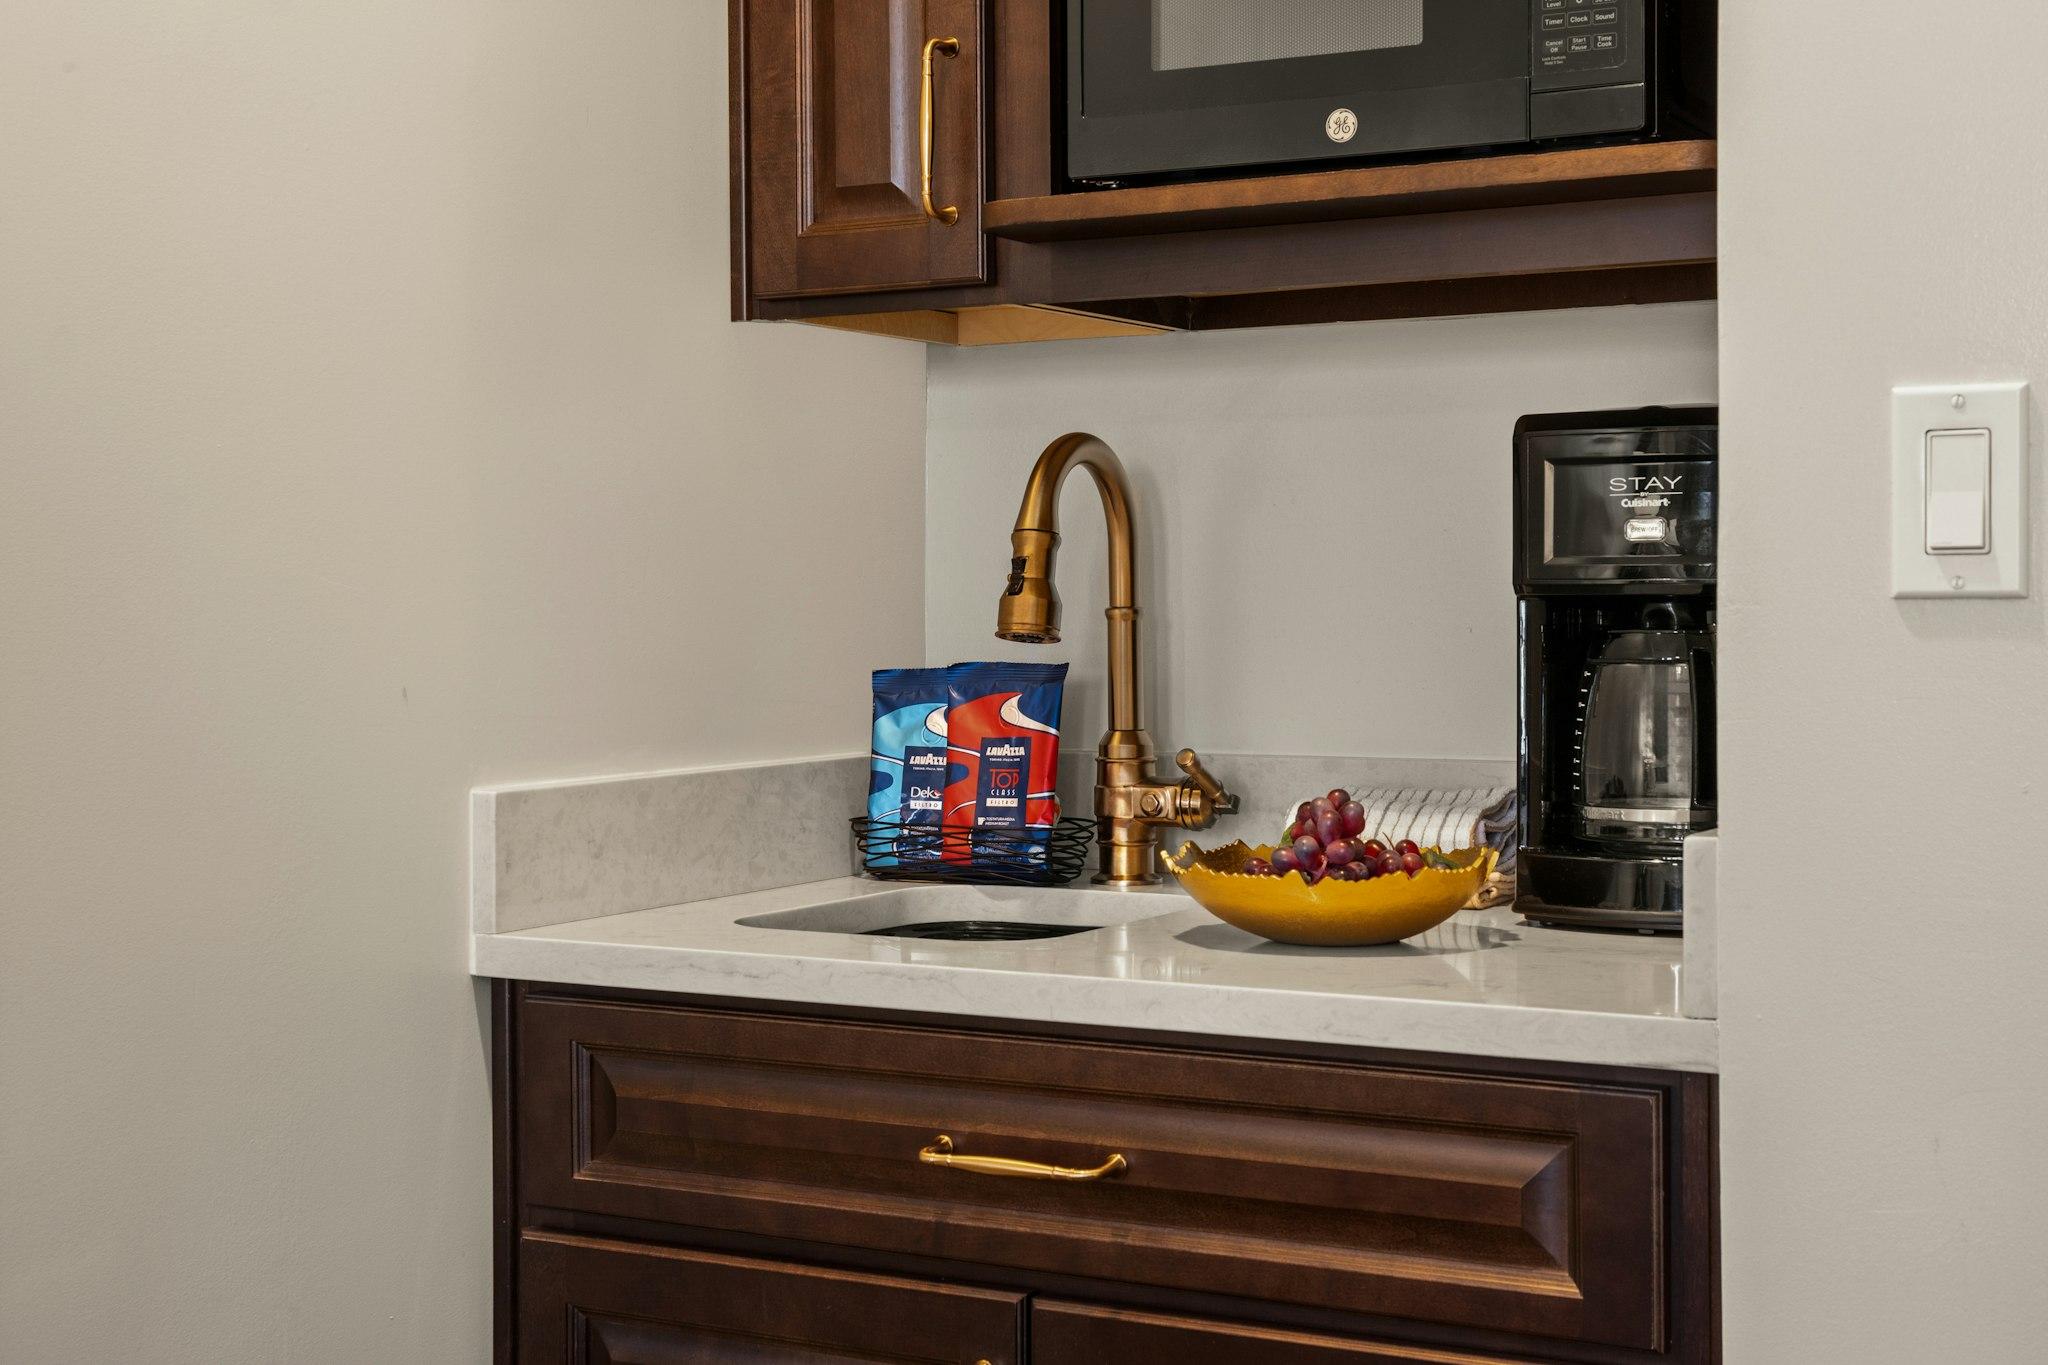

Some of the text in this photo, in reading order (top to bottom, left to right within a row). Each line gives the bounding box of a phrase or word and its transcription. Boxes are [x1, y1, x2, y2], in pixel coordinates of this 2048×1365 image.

[1545, 18, 1563, 26] Timer
[1570, 15, 1588, 23] Clock
[1595, 12, 1615, 21] Sound
[1609, 475, 1683, 492] STAY
[1620, 497, 1669, 508] Cuisinart
[985, 743, 1026, 756] LAVAZZA
[989, 768, 1020, 789] TOP
